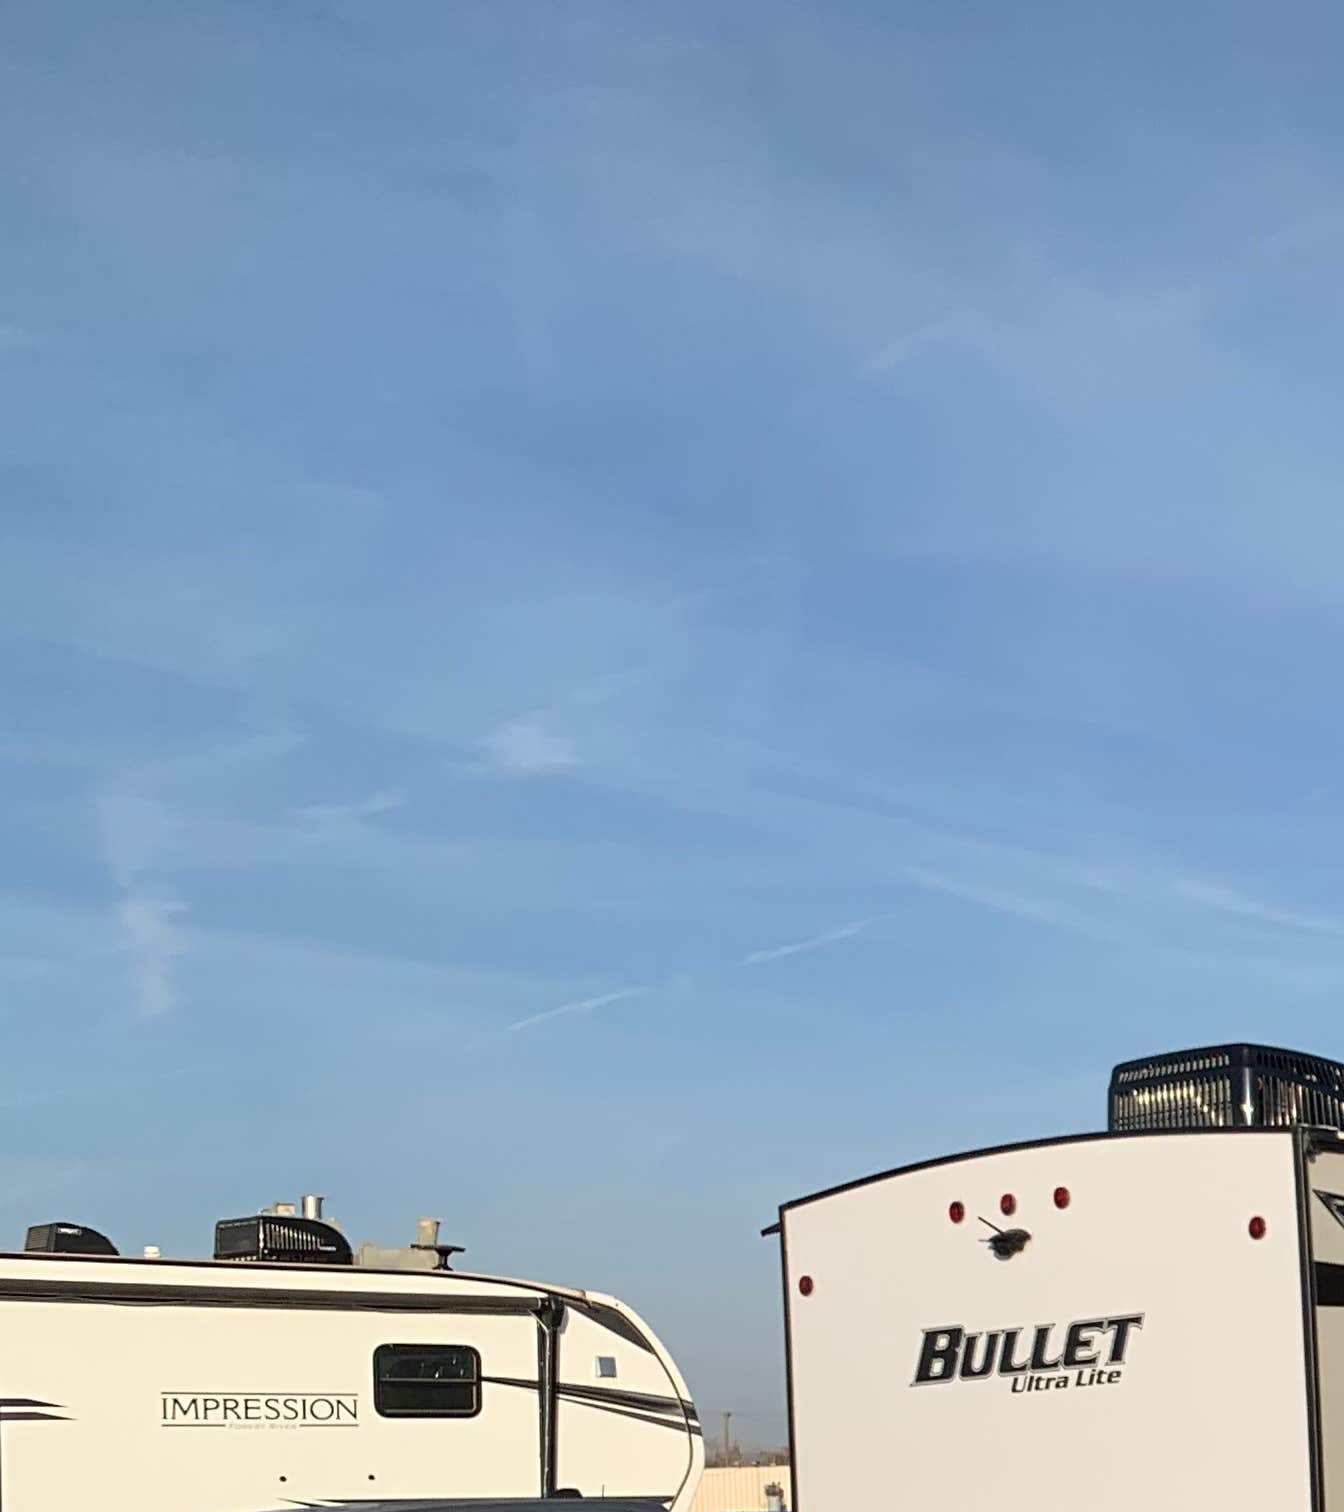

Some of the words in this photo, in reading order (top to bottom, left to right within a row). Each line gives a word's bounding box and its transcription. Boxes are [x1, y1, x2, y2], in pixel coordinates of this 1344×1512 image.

[909, 1312, 1145, 1387] BULLET
[1011, 1374, 1069, 1393] Ultra
[1075, 1368, 1121, 1387] Lite
[162, 1397, 358, 1420] IMPRESSION
